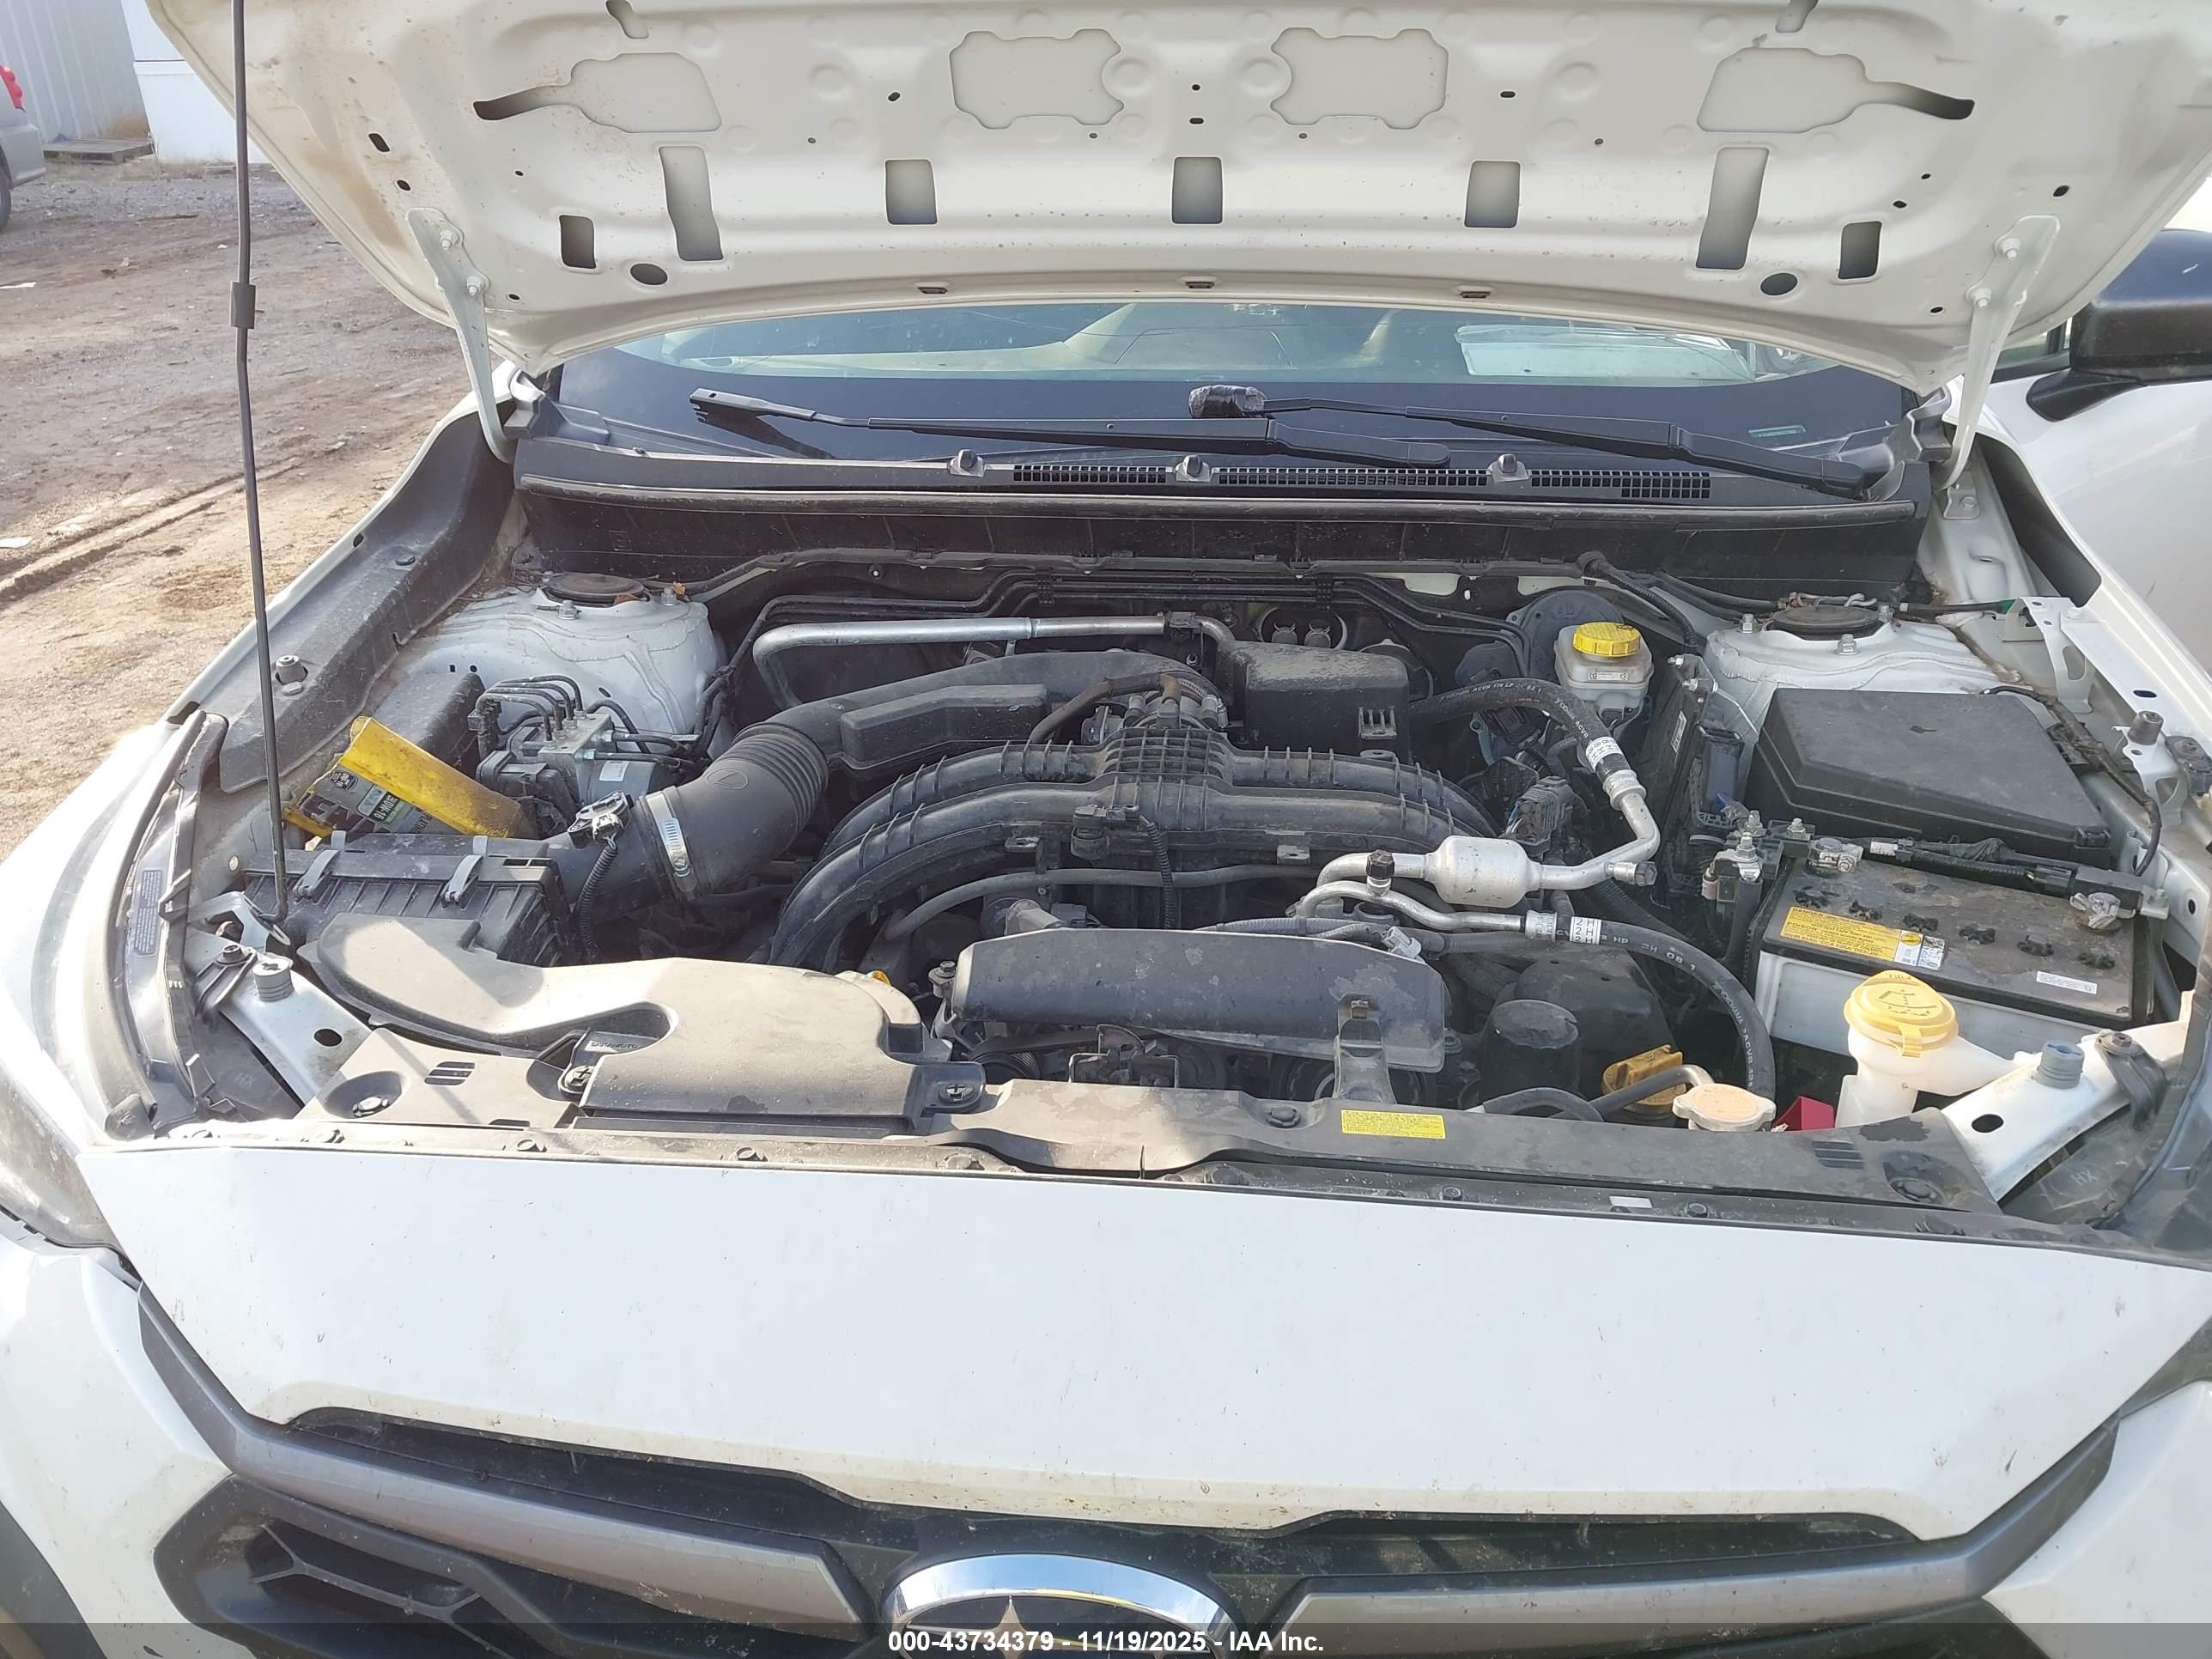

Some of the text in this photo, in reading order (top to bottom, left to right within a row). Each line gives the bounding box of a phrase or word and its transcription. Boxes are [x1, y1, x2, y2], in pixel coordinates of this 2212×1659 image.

[1575, 720, 1589, 738] ACVR
[372, 797, 396, 822] 0W-16
[1613, 935, 1630, 945] HP
[1743, 1034, 1754, 1065] ACVR
[2069, 1169, 2100, 1186] HX
